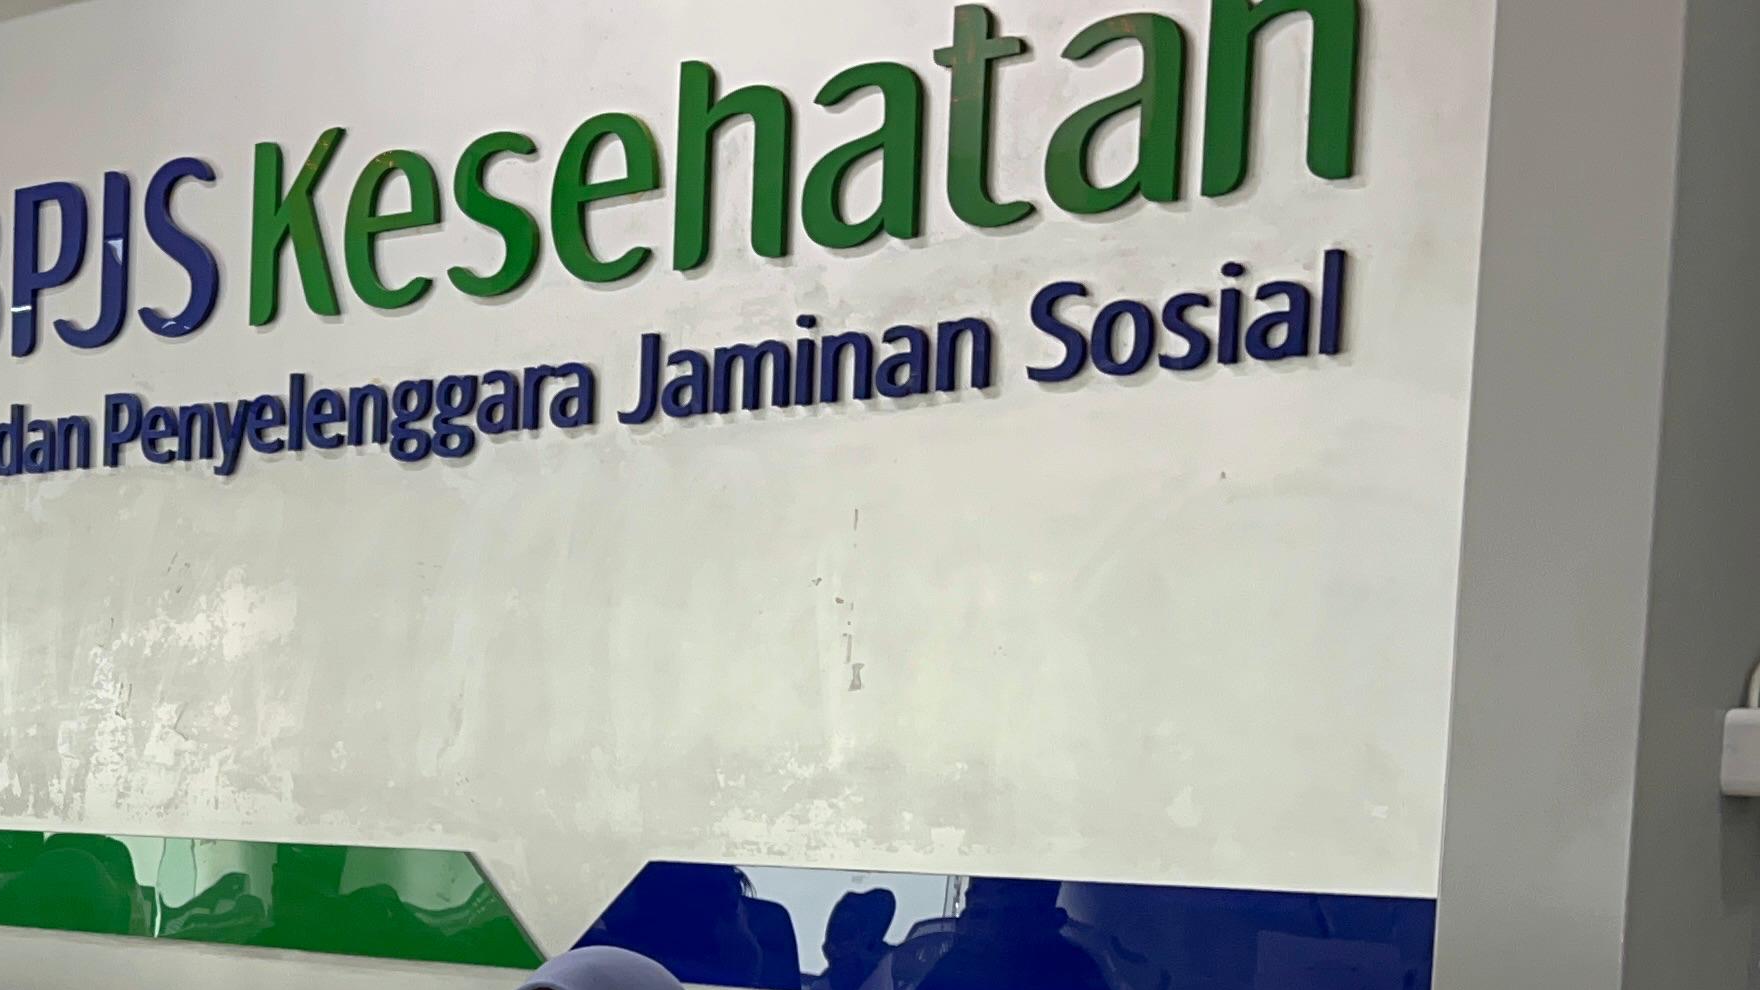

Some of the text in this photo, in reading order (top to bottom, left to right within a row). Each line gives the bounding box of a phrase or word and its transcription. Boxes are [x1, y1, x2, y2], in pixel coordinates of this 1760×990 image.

[248, 0, 1359, 327] Kesehatan
[103, 372, 596, 476] Penyelenggara
[617, 314, 992, 425] Jaminan
[1026, 248, 1346, 382] Sosial
